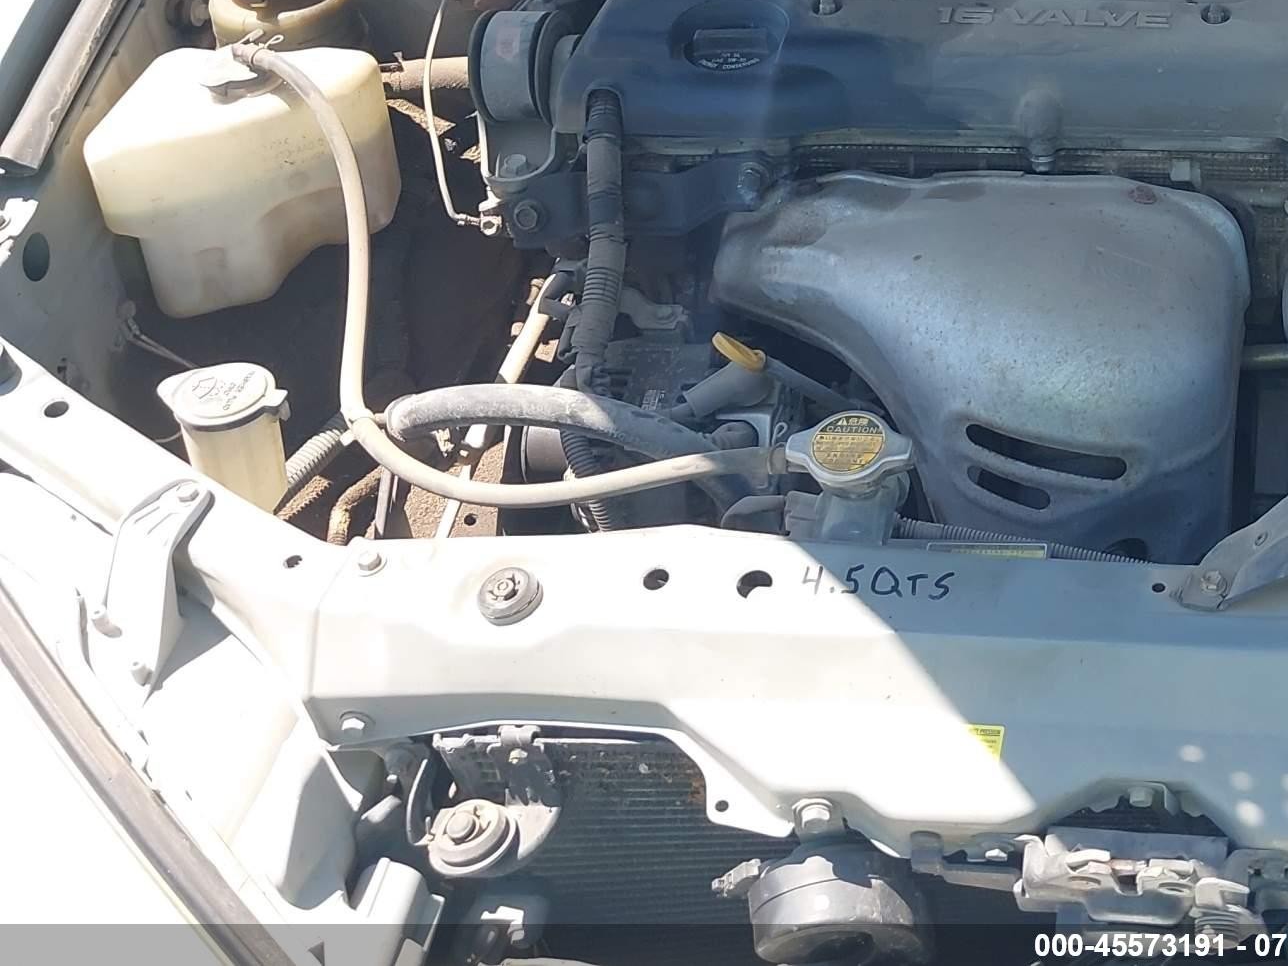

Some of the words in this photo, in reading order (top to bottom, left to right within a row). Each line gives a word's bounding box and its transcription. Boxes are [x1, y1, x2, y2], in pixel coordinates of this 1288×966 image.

[935, 7, 995, 26] 16
[1013, 8, 1173, 29] VALVE
[826, 425, 878, 434] CAUTION
